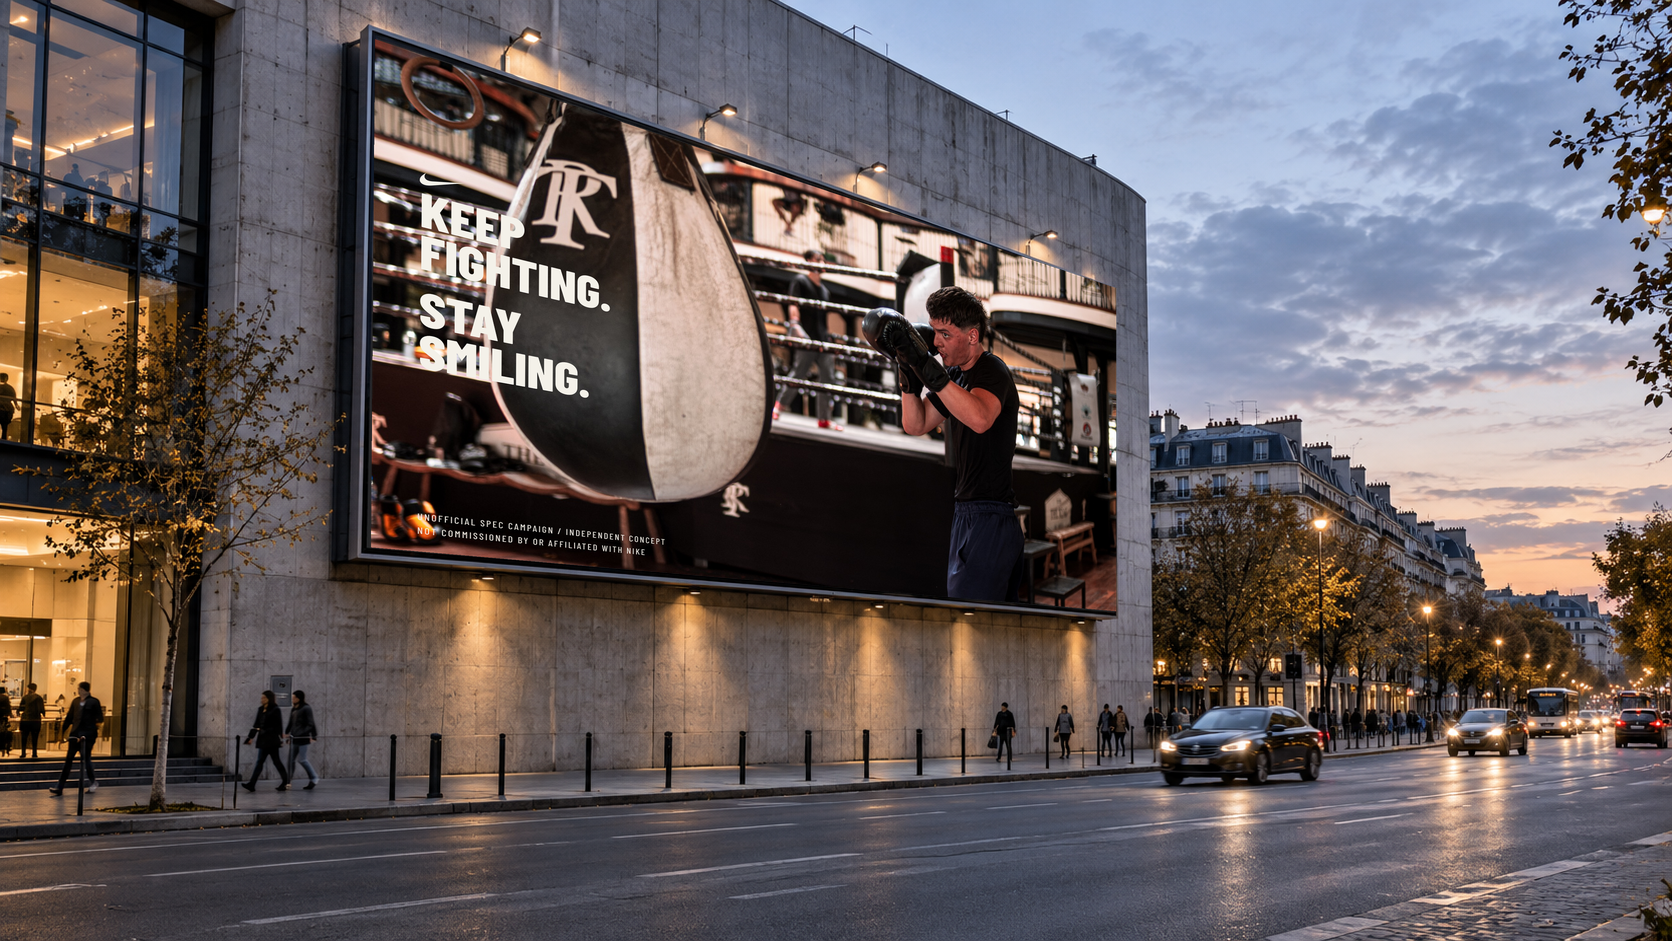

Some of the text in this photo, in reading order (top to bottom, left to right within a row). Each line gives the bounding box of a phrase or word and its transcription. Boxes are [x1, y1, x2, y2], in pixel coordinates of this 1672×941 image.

[421, 193, 525, 249] KEEP
[421, 236, 611, 312] FIGHTING.
[420, 293, 521, 344] STAY
[420, 335, 589, 398] SMILING.
[417, 513, 476, 527] UNOFFICIAL
[480, 519, 504, 529] SPEC
[508, 522, 554, 534] CAMPAIGN
[565, 528, 625, 541] INDEPENDENT
[628, 535, 666, 546] CONCEPT
[417, 527, 646, 556] NOT COMMISSIONED BY OR AFFILIATED WITH NIKE
